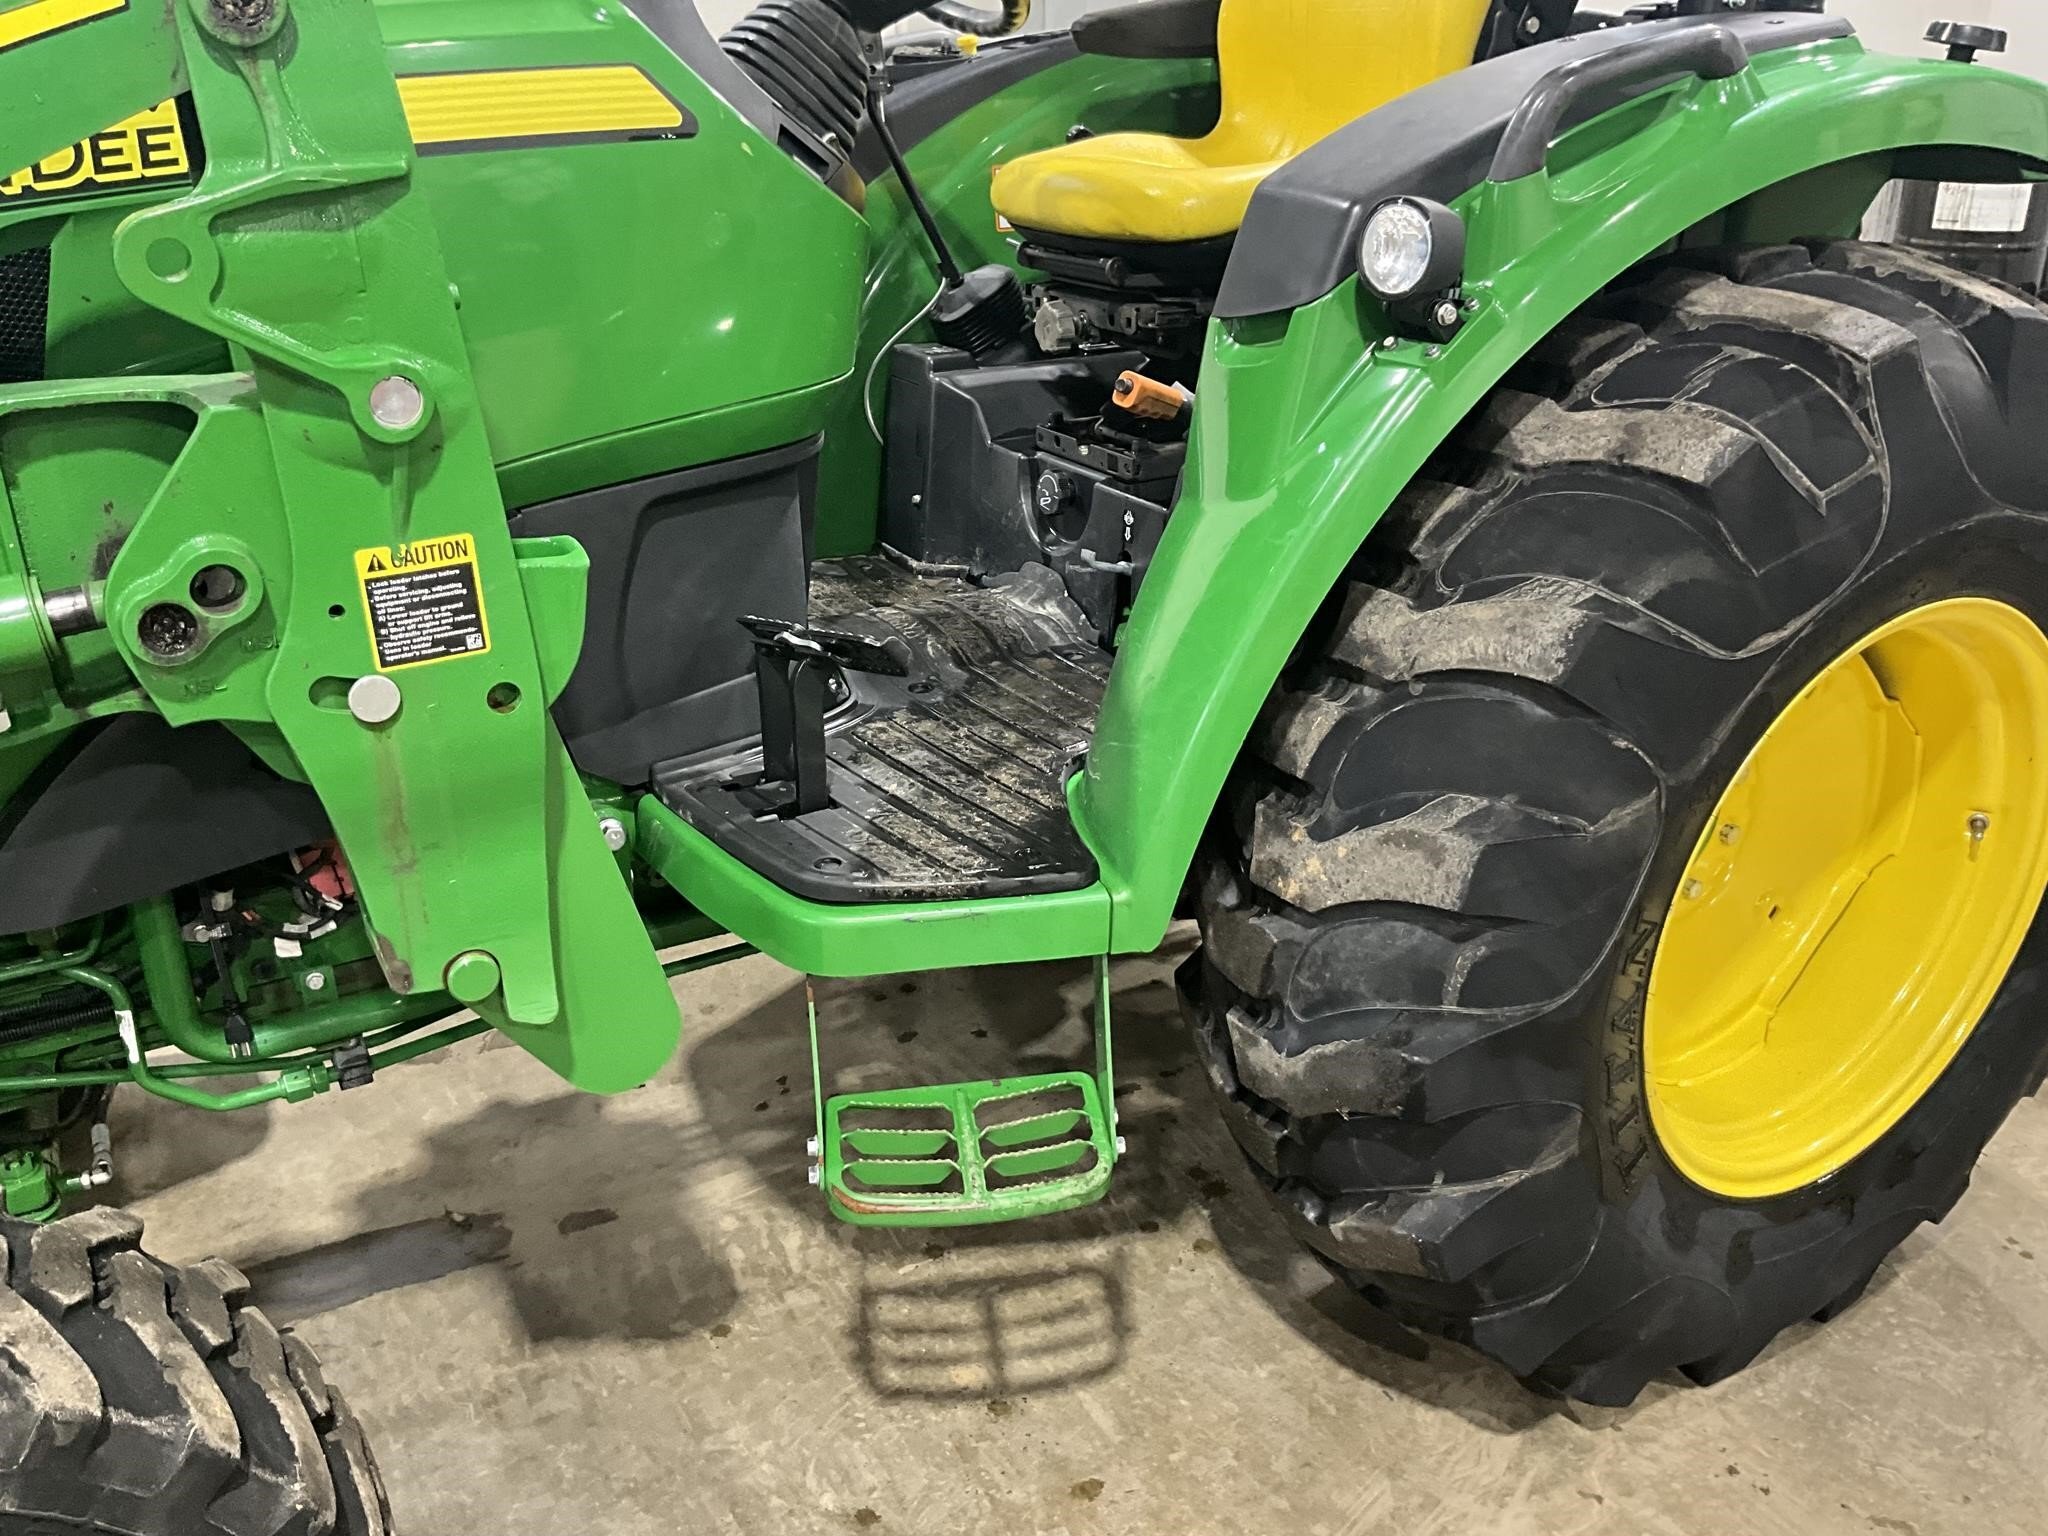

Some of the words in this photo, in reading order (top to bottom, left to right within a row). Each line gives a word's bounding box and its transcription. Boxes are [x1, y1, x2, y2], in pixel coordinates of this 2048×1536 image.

[391, 540, 468, 567] CAUTION
[371, 580, 389, 588] Lock
[389, 577, 412, 585] loader
[412, 573, 437, 581] latches
[437, 569, 460, 577] before
[373, 593, 397, 601] Before
[431, 582, 462, 592] adjusting
[375, 597, 411, 608] equipment
[386, 612, 408, 620] Lower
[408, 608, 431, 616] loader
[440, 601, 463, 611] ground
[389, 625, 405, 633] Shut
[417, 620, 440, 628] engine
[396, 616, 423, 625] support
[383, 639, 411, 648] Observe
[412, 635, 433, 643] safety
[410, 641, 432, 650] loader
[1604, 908, 1658, 1193] TITAN
